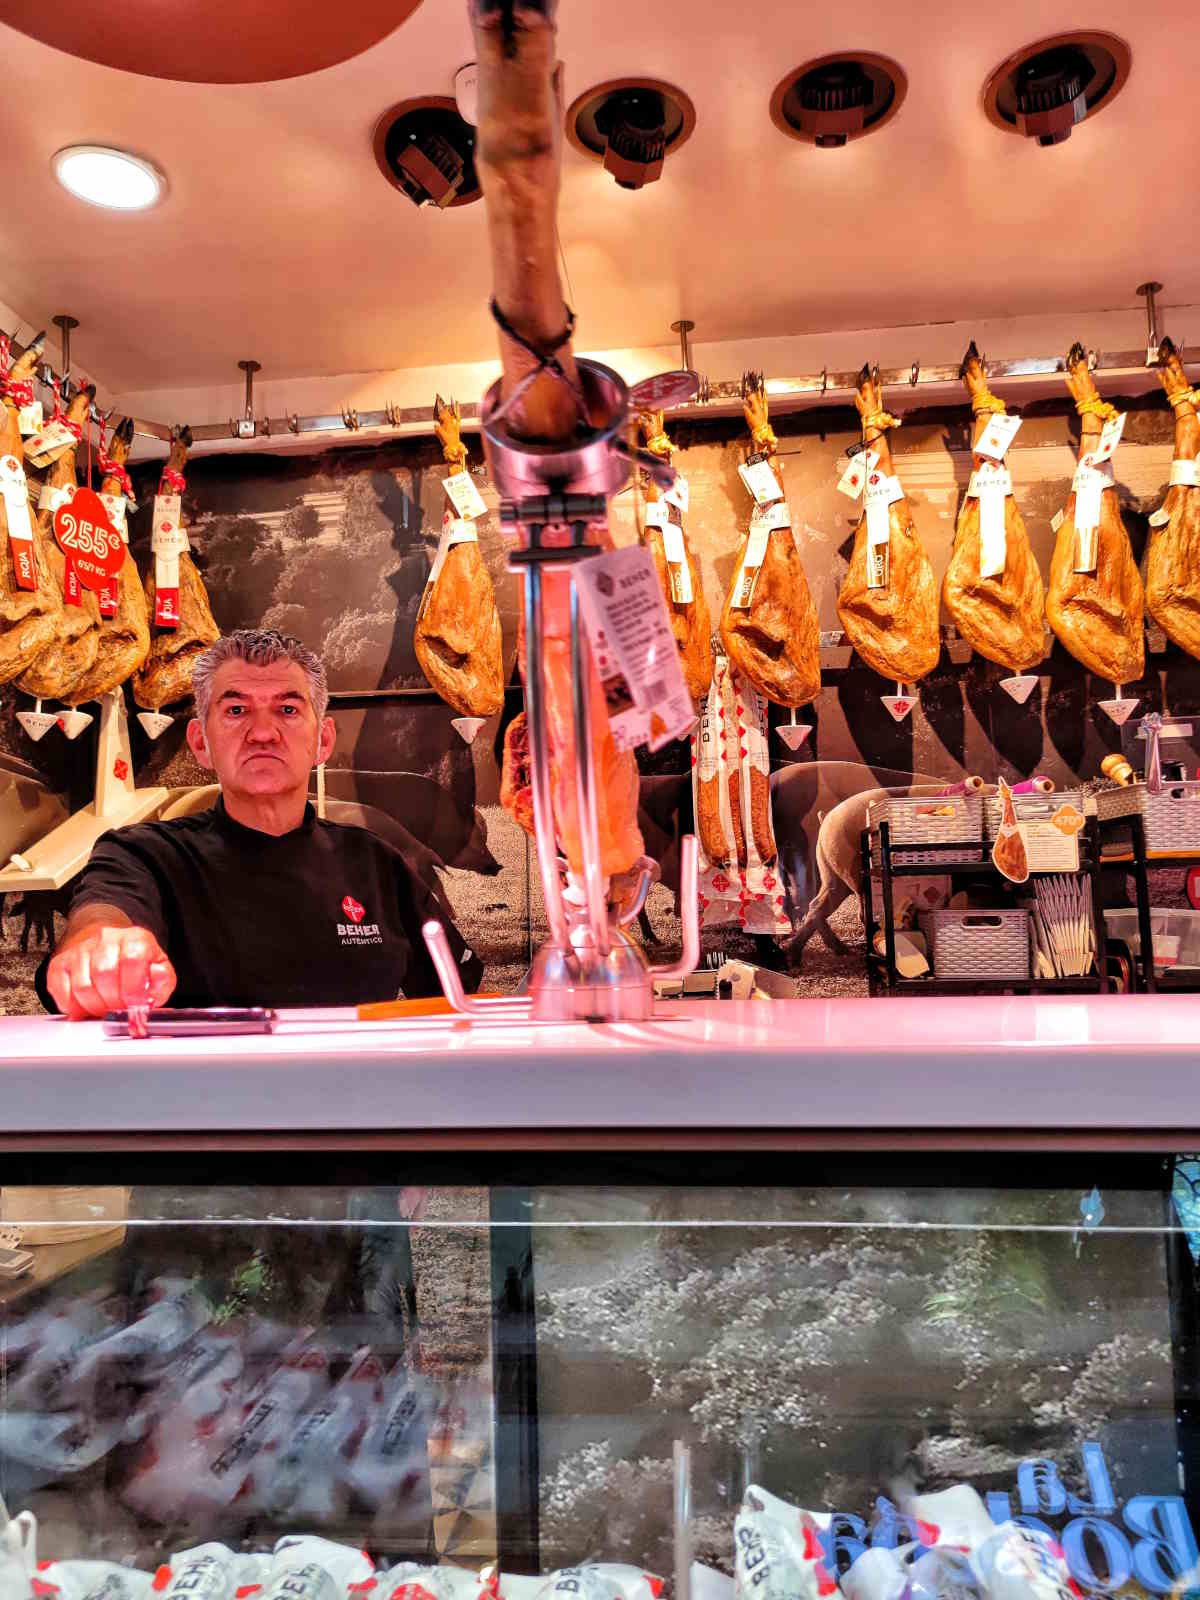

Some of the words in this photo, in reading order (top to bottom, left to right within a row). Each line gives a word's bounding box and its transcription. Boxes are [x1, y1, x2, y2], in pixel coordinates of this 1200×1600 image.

[18, 551, 31, 579] ROJA
[100, 587, 111, 609] ROJA
[336, 923, 380, 936] BEHER
